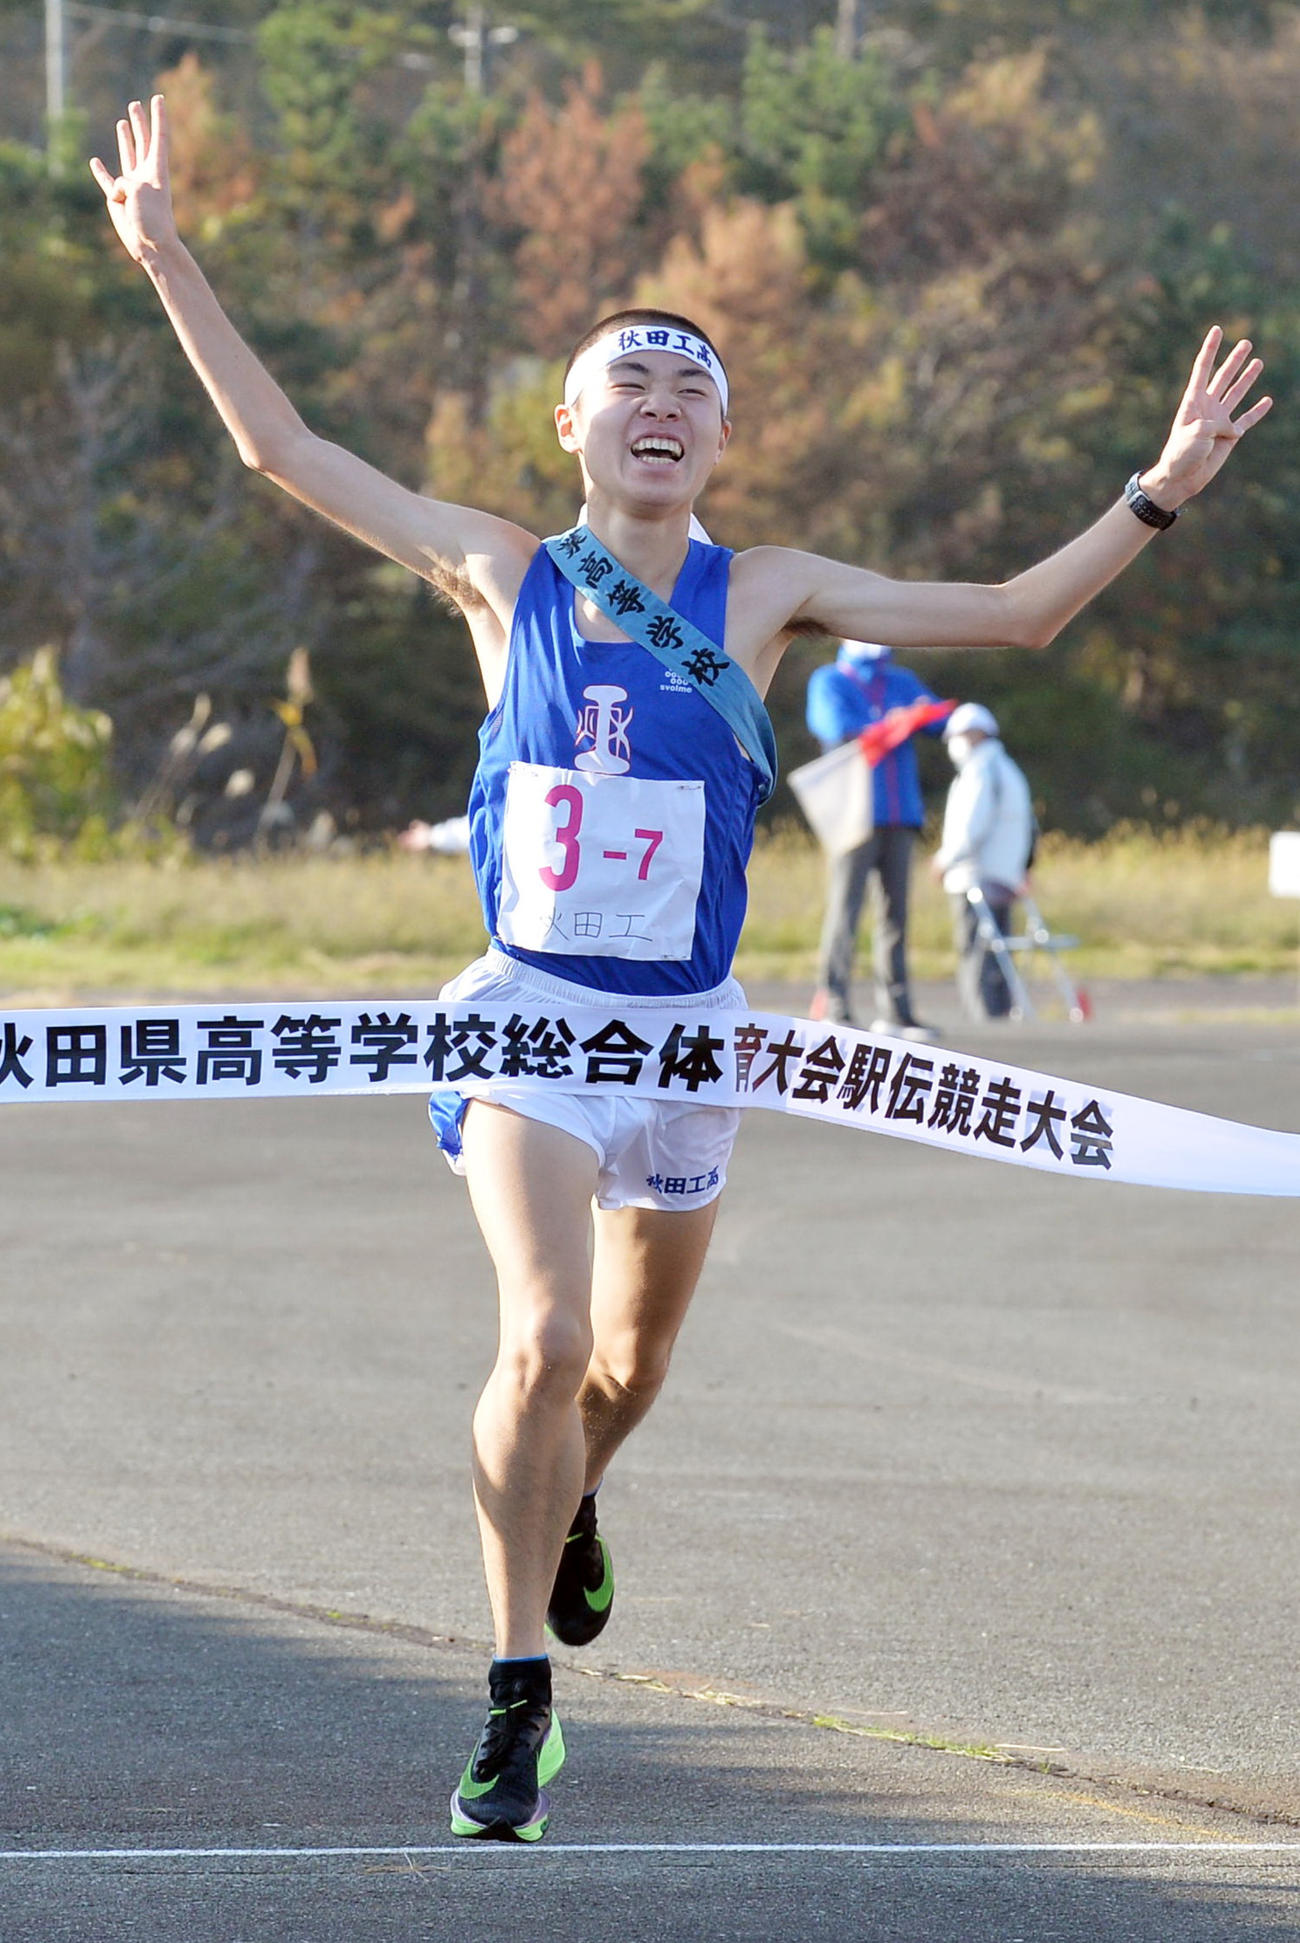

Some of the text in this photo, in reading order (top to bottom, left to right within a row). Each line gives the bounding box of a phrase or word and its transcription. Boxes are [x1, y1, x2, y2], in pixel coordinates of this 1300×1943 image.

[619, 330, 713, 369] 秋田工高
[660, 685, 693, 693] svolme
[646, 1165, 719, 1194] 秋田工高
